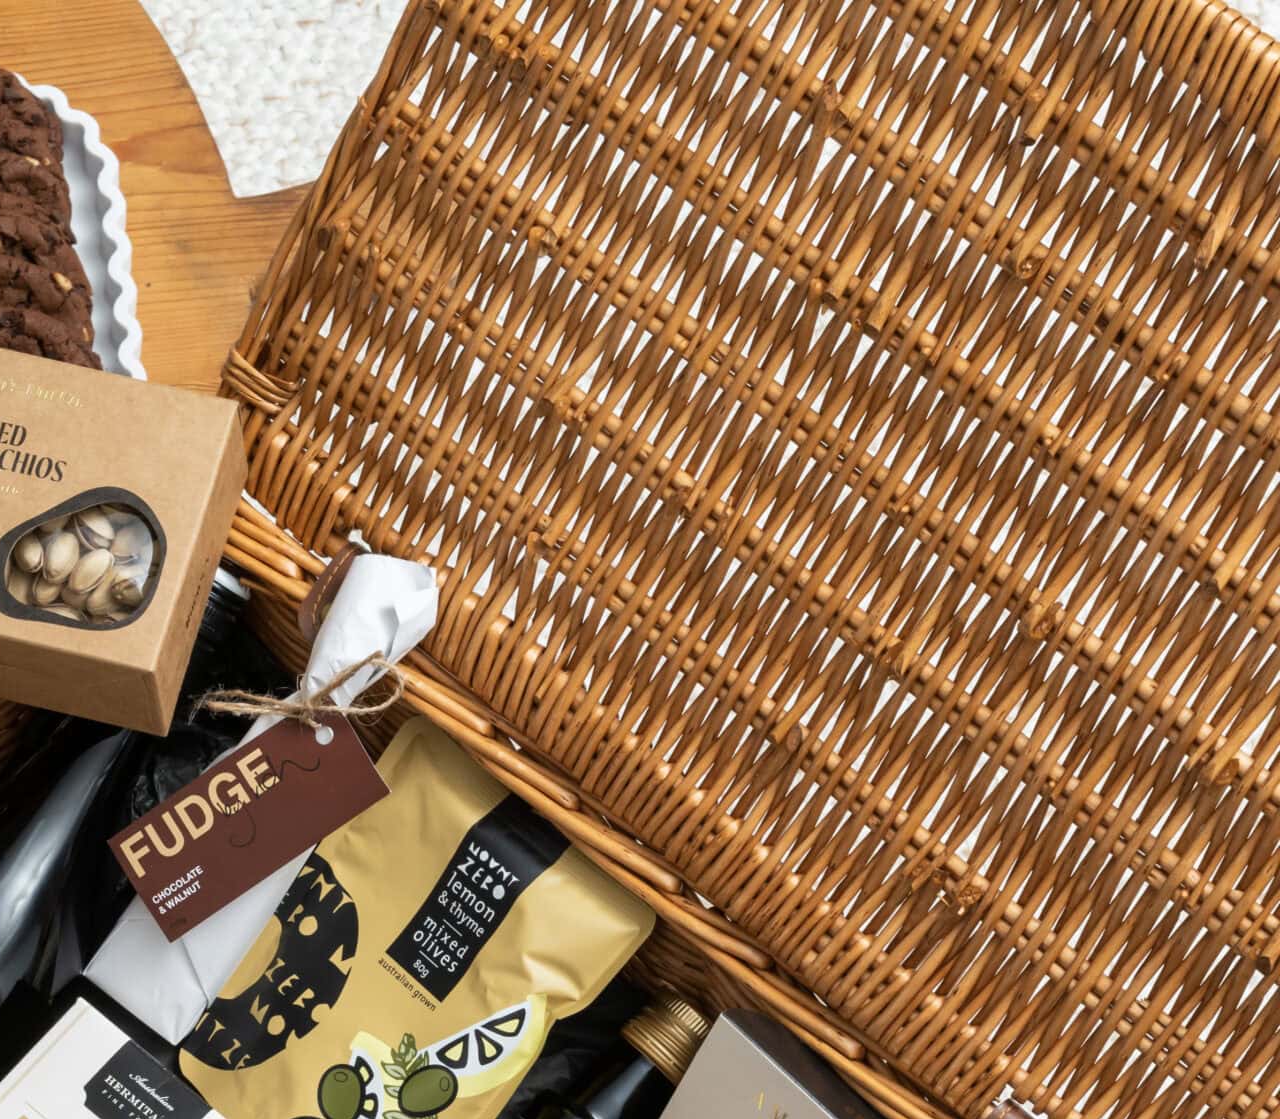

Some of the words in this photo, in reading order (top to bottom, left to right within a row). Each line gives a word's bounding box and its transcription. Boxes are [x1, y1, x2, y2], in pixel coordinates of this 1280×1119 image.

[120, 748, 280, 878] FUDGE
[152, 865, 204, 905] CHOCOLATE
[158, 904, 167, 915] &
[166, 881, 202, 911] WALNUT
[447, 871, 495, 922] lemon
[457, 857, 506, 900] ZERO
[438, 890, 449, 907] &
[449, 900, 485, 938] thyme
[413, 930, 458, 973] olives
[423, 916, 469, 959] mixed
[378, 958, 413, 994] australian
[411, 987, 436, 1012] grown
[413, 959, 430, 979] 80g
[101, 1089, 125, 1111] FINE
[128, 1072, 175, 1112] Australian
